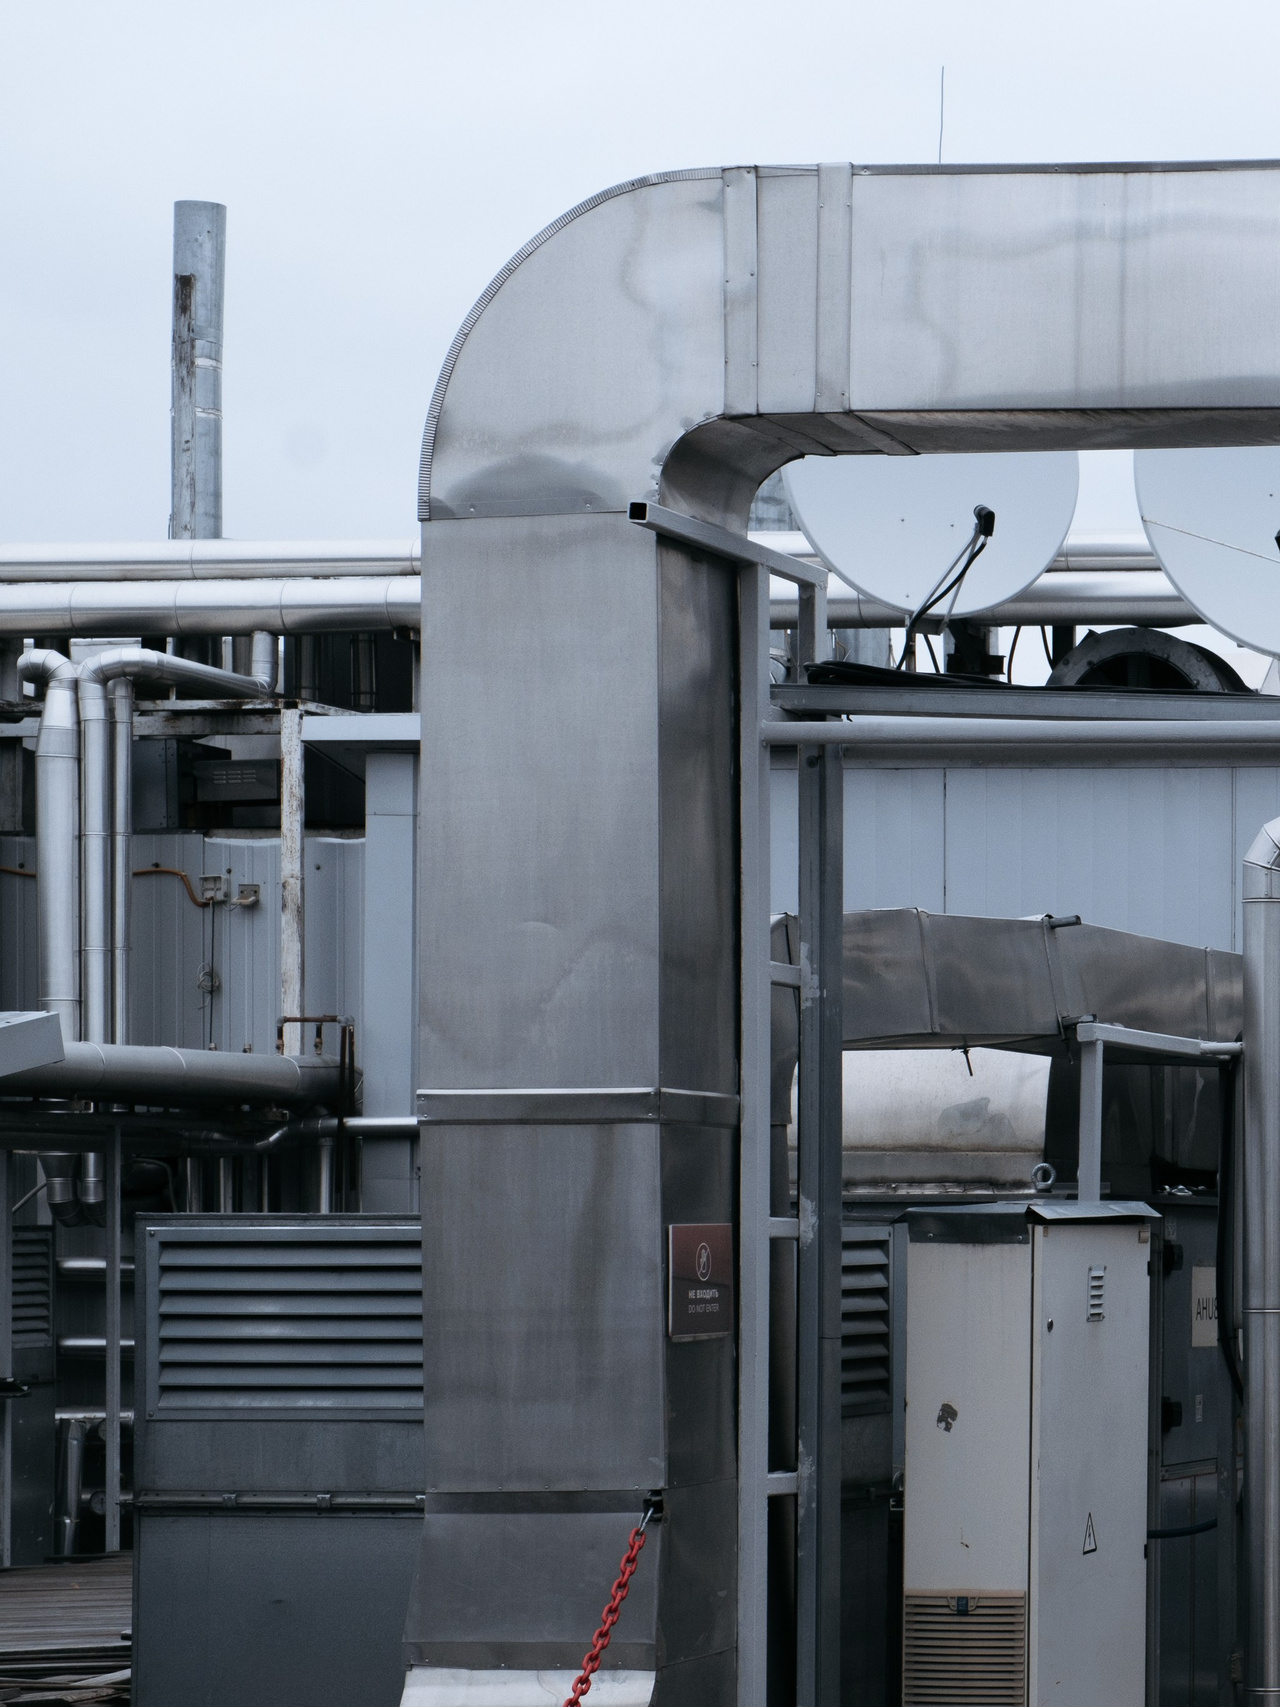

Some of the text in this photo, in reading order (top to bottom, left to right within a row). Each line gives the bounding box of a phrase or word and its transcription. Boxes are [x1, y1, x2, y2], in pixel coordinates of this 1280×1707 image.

[688, 1289, 719, 1300] НЕ ВХОДИТЬ
[688, 1303, 720, 1313] DO NOT ENTER
